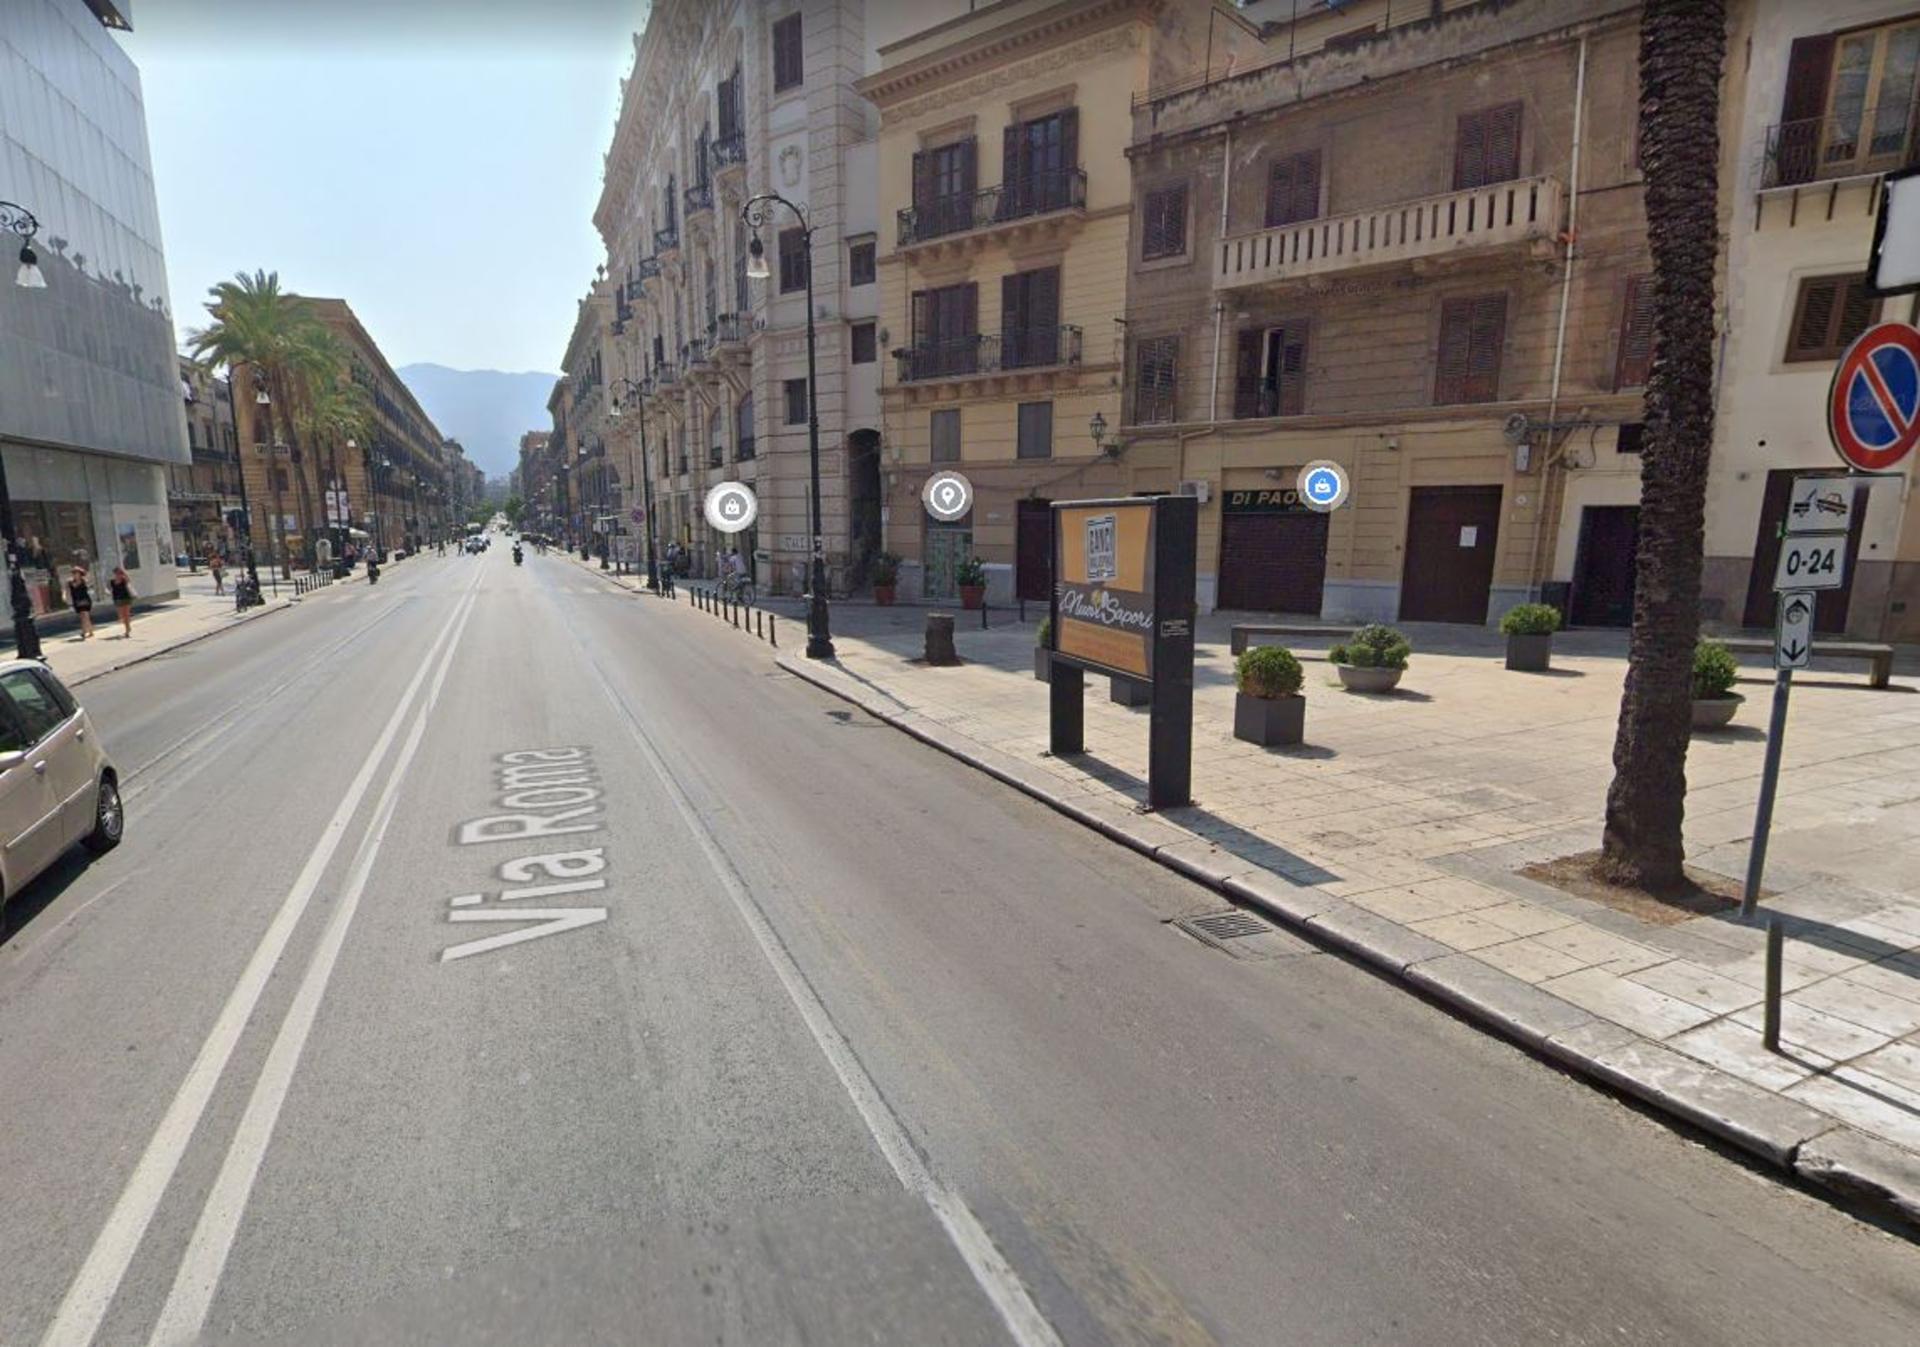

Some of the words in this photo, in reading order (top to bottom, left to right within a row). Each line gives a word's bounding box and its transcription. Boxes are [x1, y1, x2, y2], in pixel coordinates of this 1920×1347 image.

[1231, 492, 1252, 504] DI
[1257, 490, 1300, 504] PAO
[1787, 549, 1835, 576] 0-24
[1101, 598, 1153, 627] Sapori
